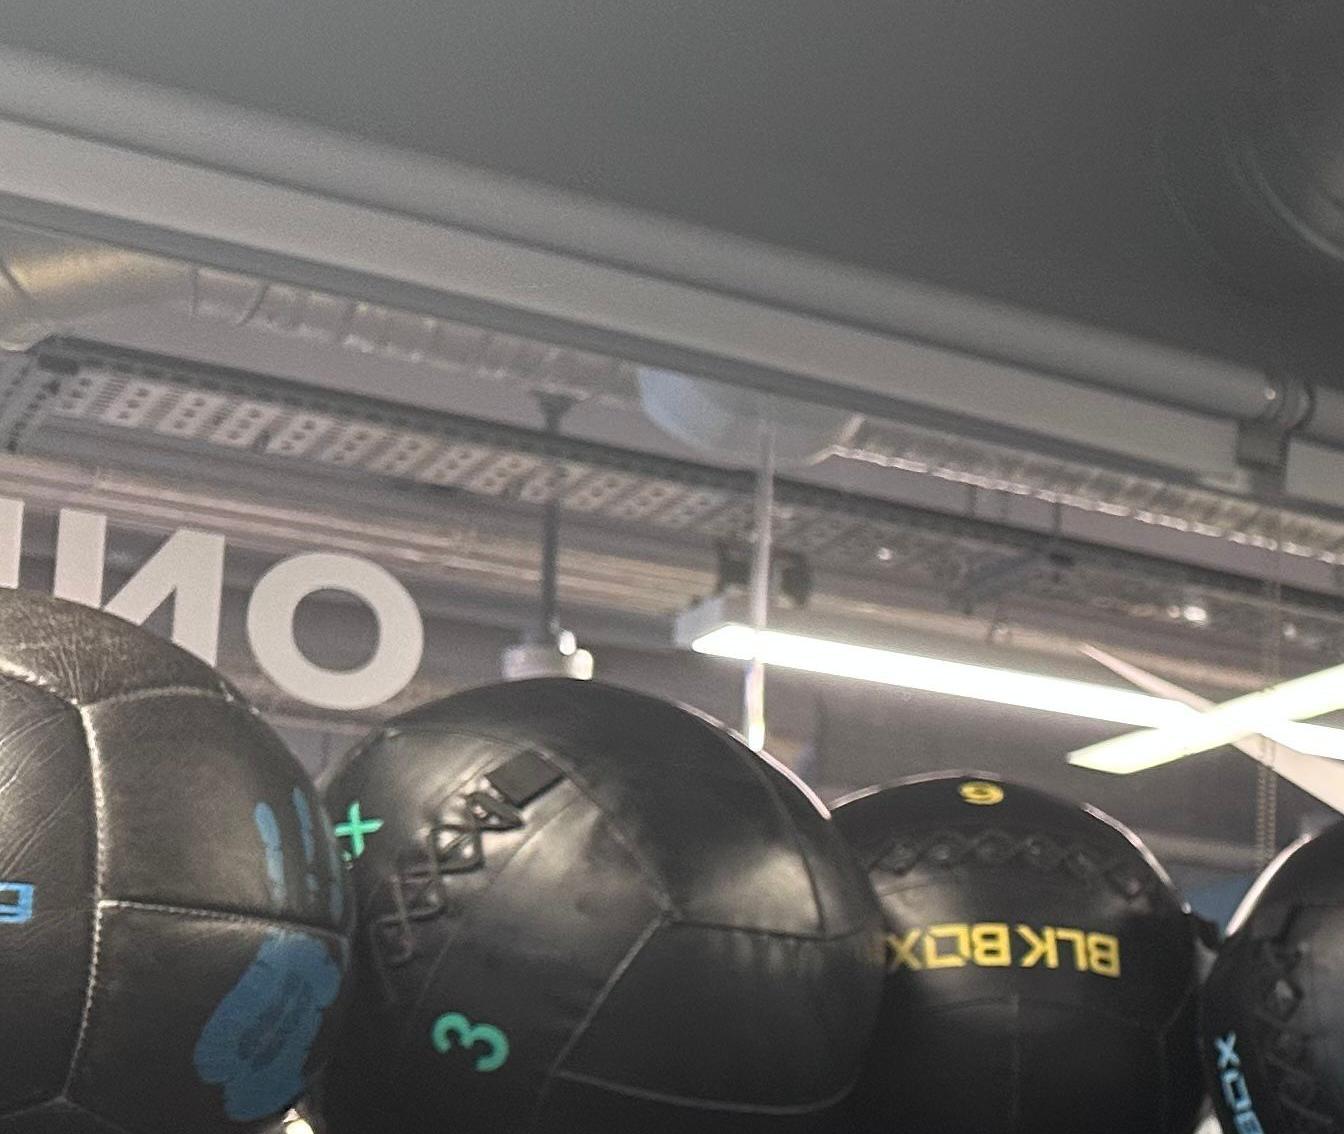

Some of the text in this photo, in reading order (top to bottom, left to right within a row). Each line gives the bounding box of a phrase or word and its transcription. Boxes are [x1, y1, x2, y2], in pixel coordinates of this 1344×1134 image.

[887, 922, 1121, 979] BLK BOX
[432, 1011, 509, 1072] 3
